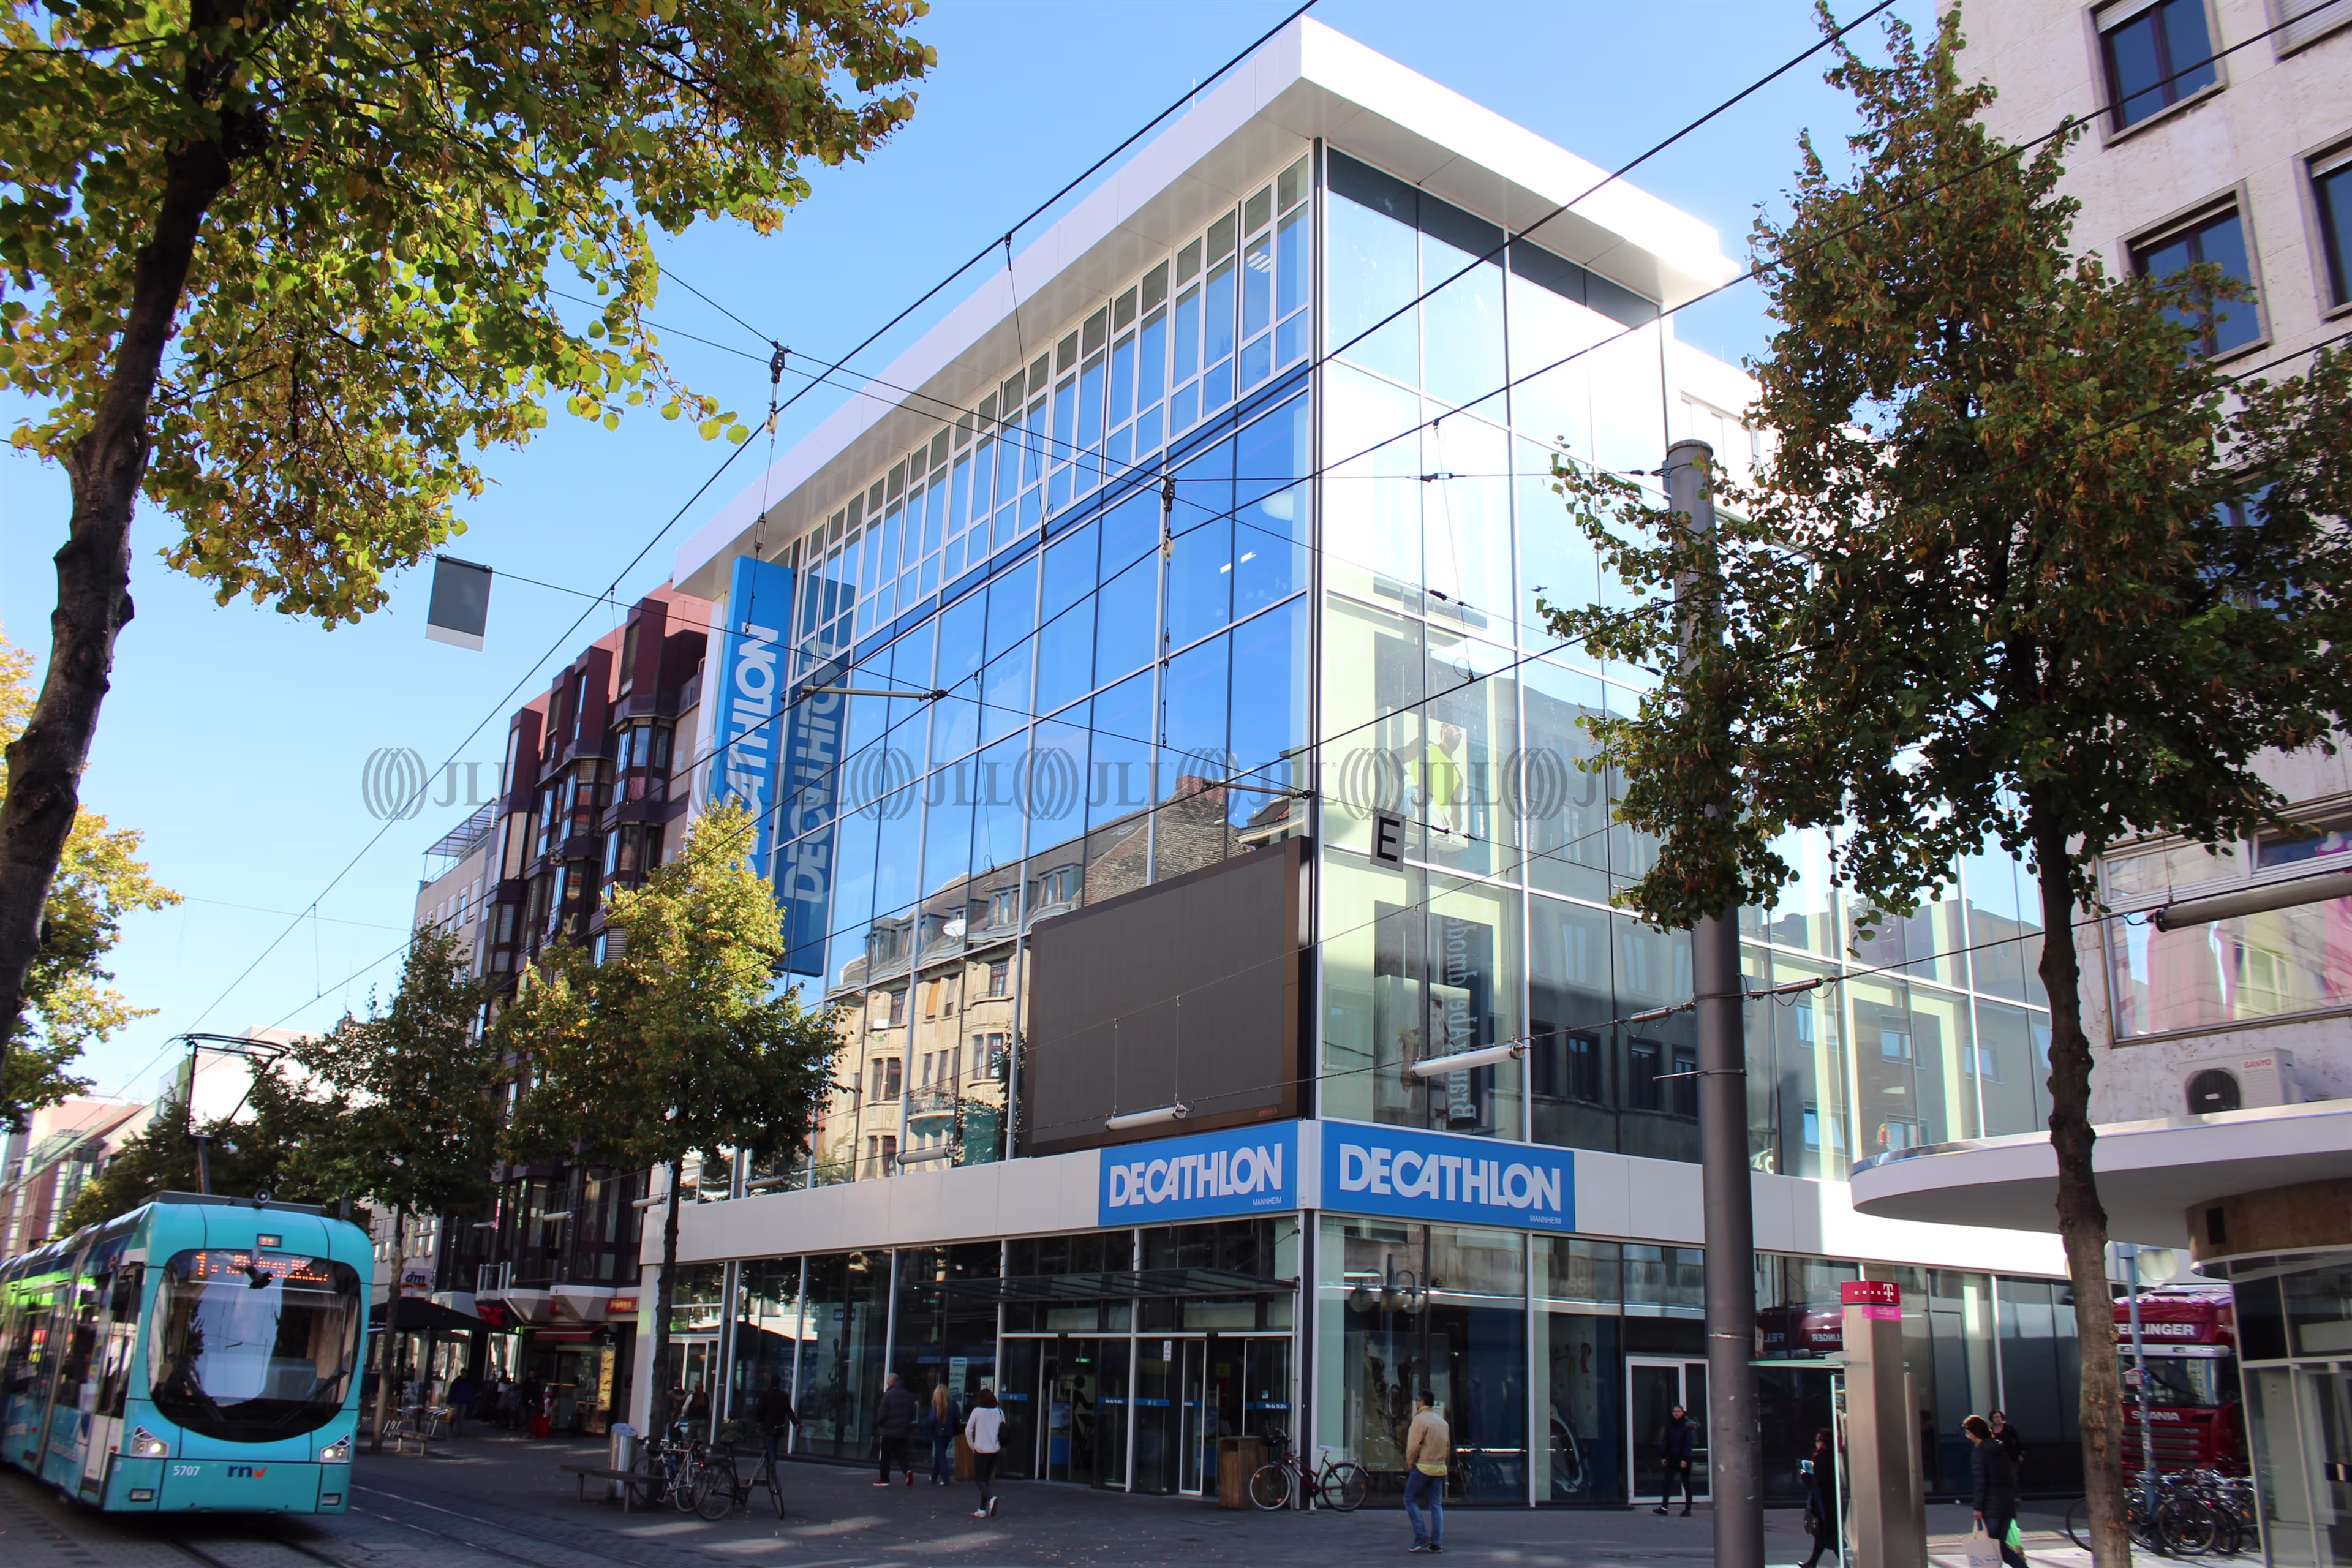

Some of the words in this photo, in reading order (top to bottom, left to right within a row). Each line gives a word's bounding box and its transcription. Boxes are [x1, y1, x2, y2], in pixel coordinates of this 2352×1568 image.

[723, 622, 778, 873] CATHLON
[1377, 816, 1400, 862] E
[2243, 1058, 2272, 1068] SANYO
[1109, 1143, 1283, 1207] DECATHLON
[1339, 1143, 1561, 1212] DECATHLON
[1253, 1196, 1282, 1206] MANNHEIM
[1529, 1215, 1561, 1224] MANNHEIM
[405, 1271, 426, 1283] dm
[1883, 1283, 1894, 1302] T
[2114, 1323, 2195, 1336] ELINGER
[2132, 1410, 2180, 1422] SANIA
[173, 1465, 200, 1477] 5707
[227, 1465, 268, 1479] rnv
